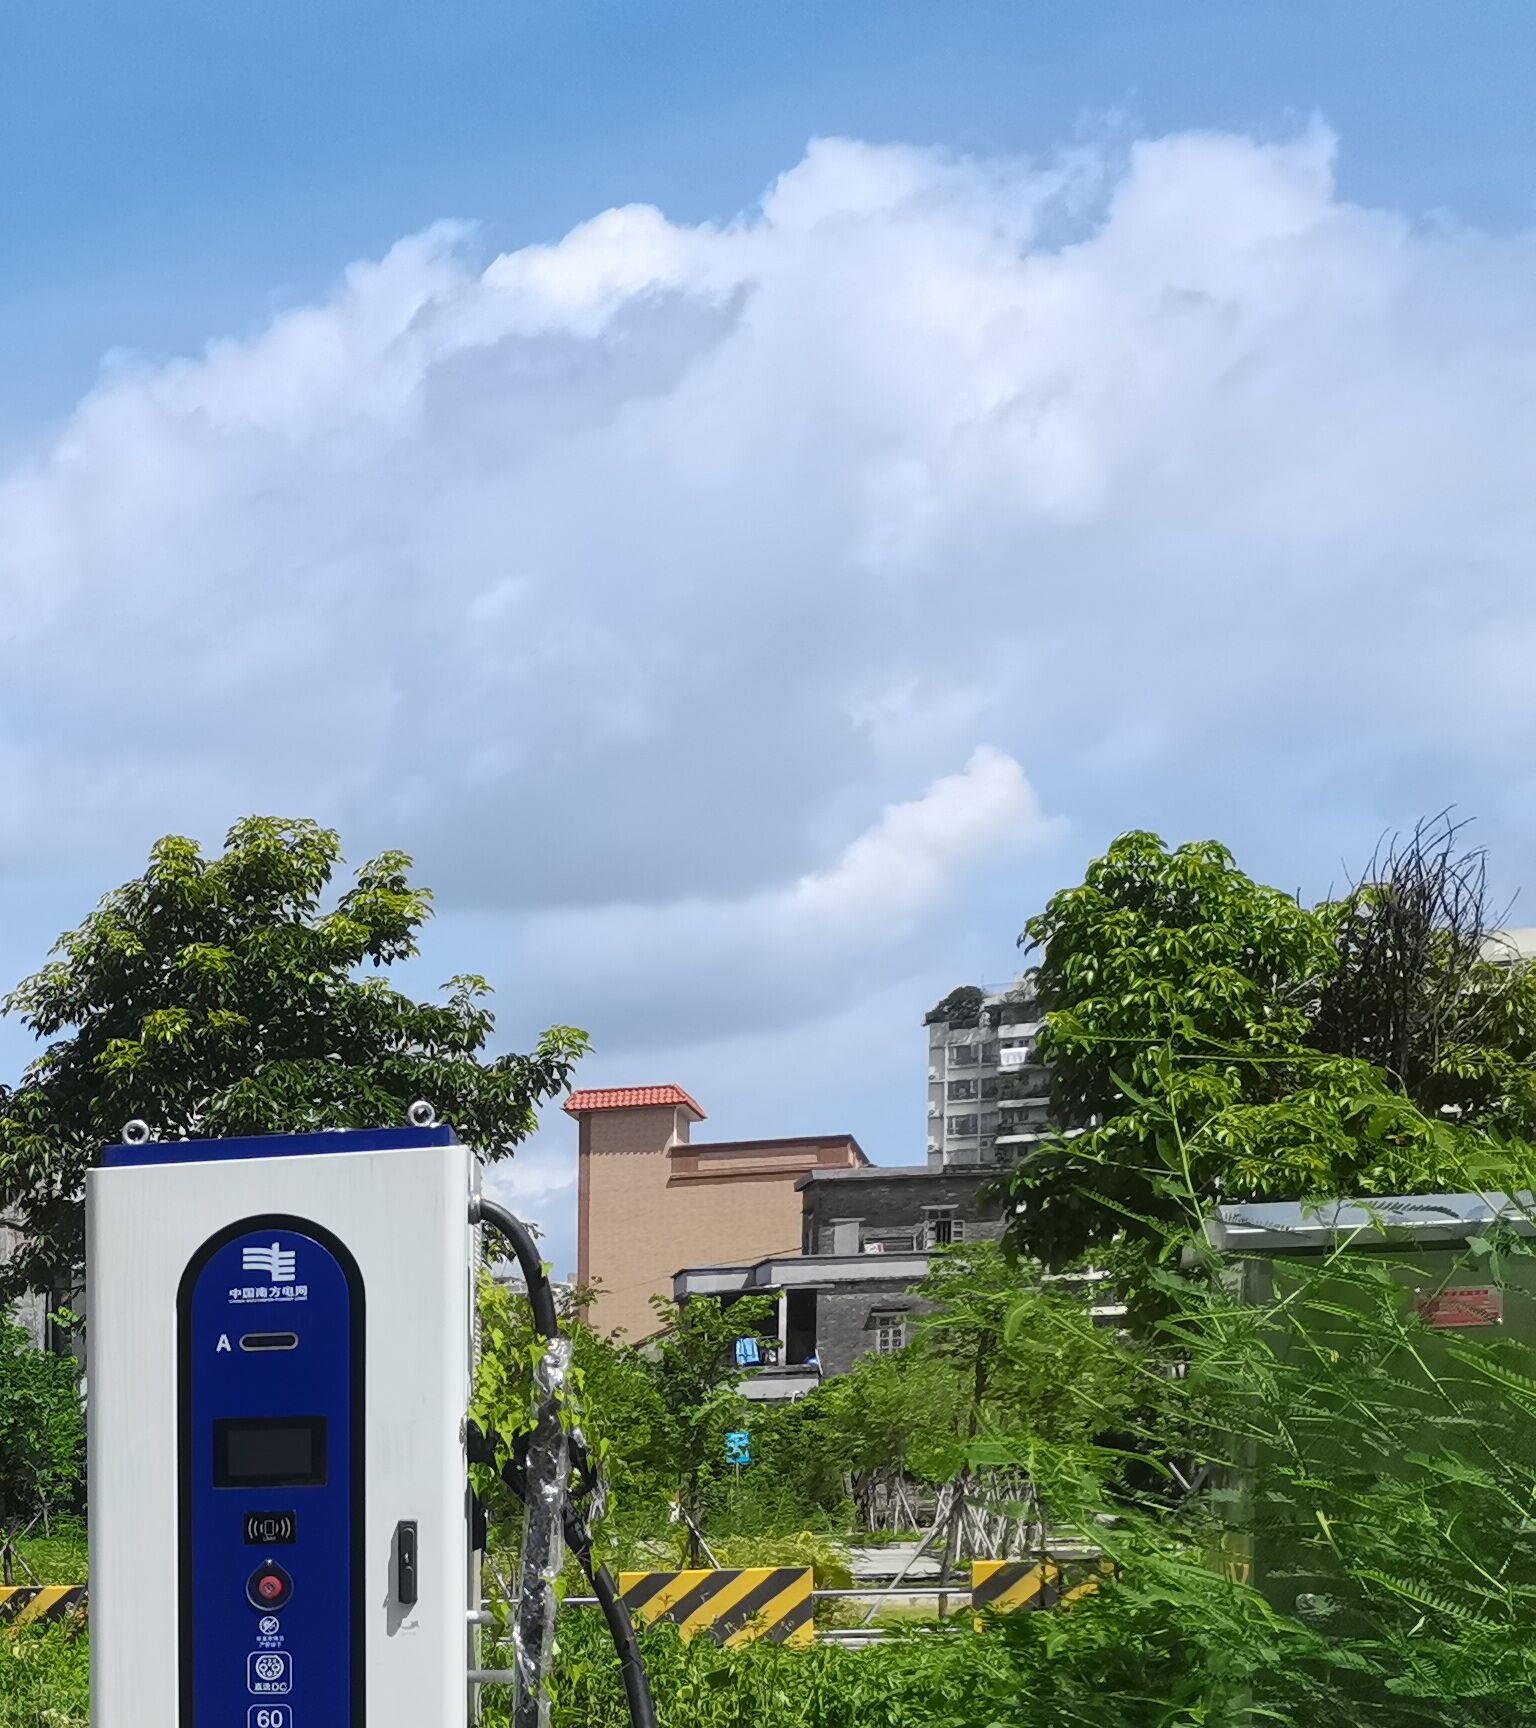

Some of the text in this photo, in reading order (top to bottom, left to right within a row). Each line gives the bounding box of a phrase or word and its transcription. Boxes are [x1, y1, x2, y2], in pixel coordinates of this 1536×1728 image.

[229, 1285, 307, 1299] 中国南方电网
[216, 1333, 232, 1352] A
[256, 1709, 283, 1728] 60
